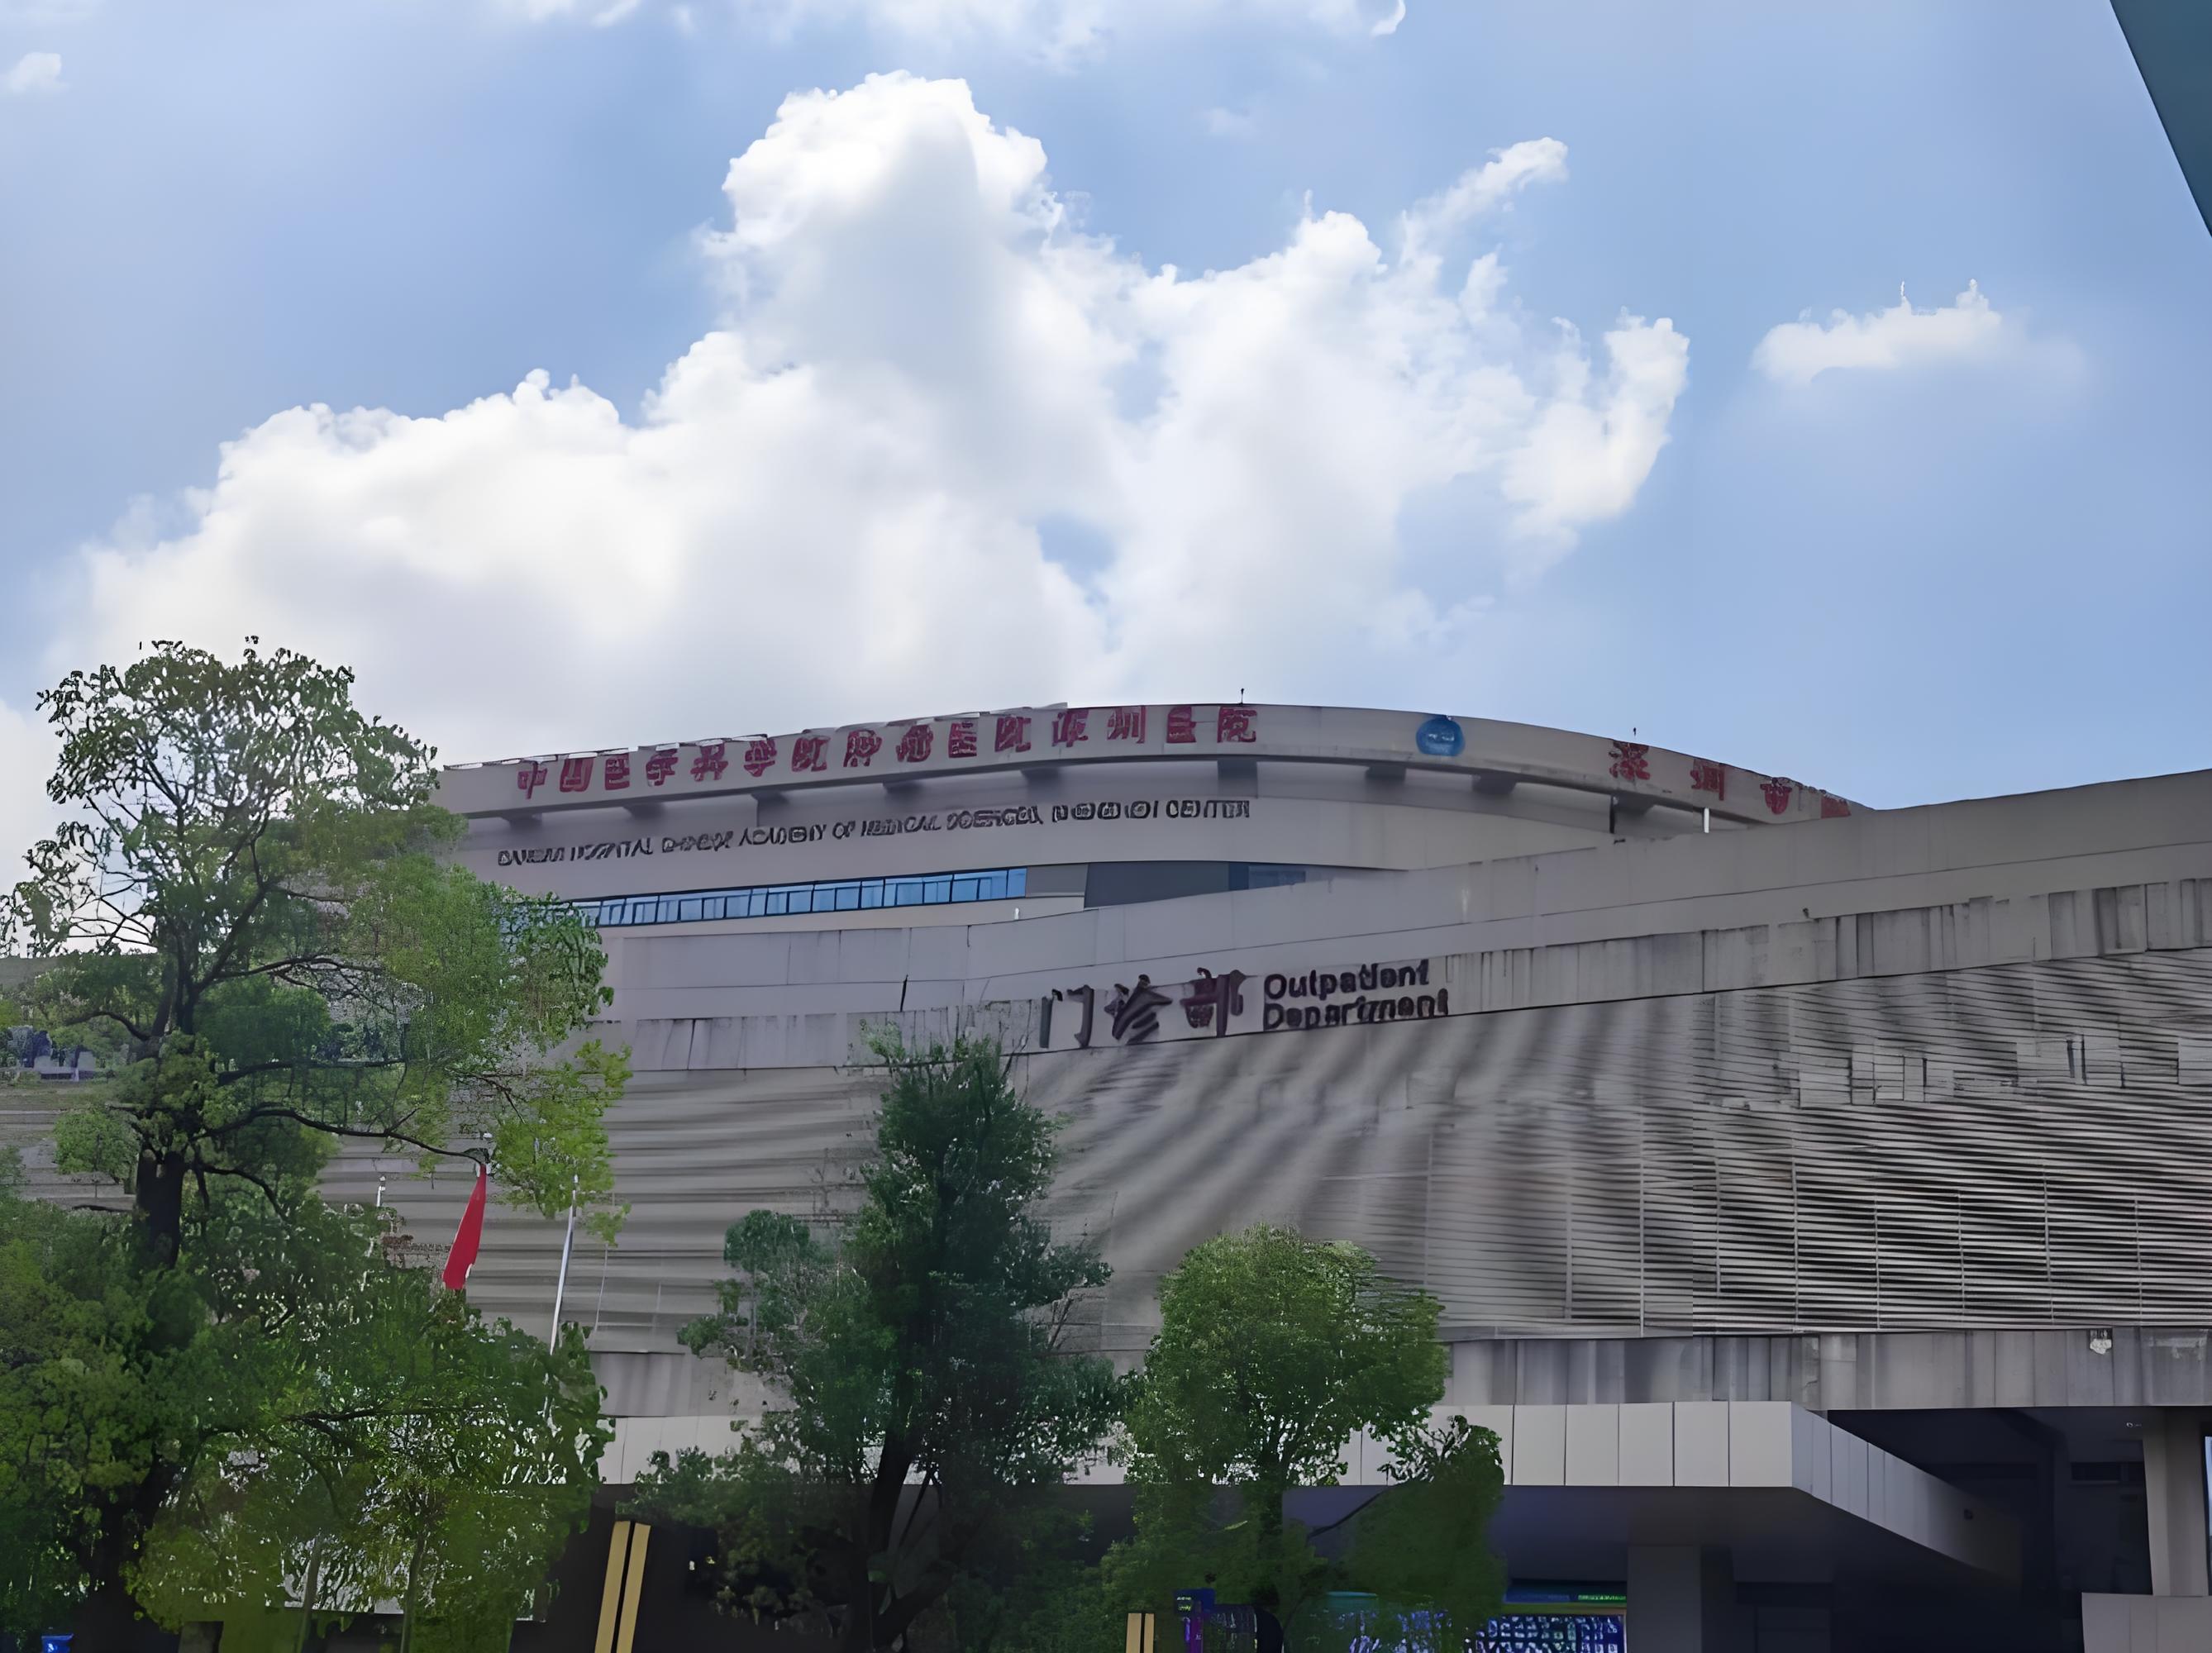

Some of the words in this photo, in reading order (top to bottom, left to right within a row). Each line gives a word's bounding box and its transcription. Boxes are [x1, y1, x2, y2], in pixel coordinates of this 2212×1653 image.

[1264, 959, 1429, 1001] Outpatient
[1038, 967, 1246, 1048] 门诊部
[1264, 988, 1449, 1031] Department
